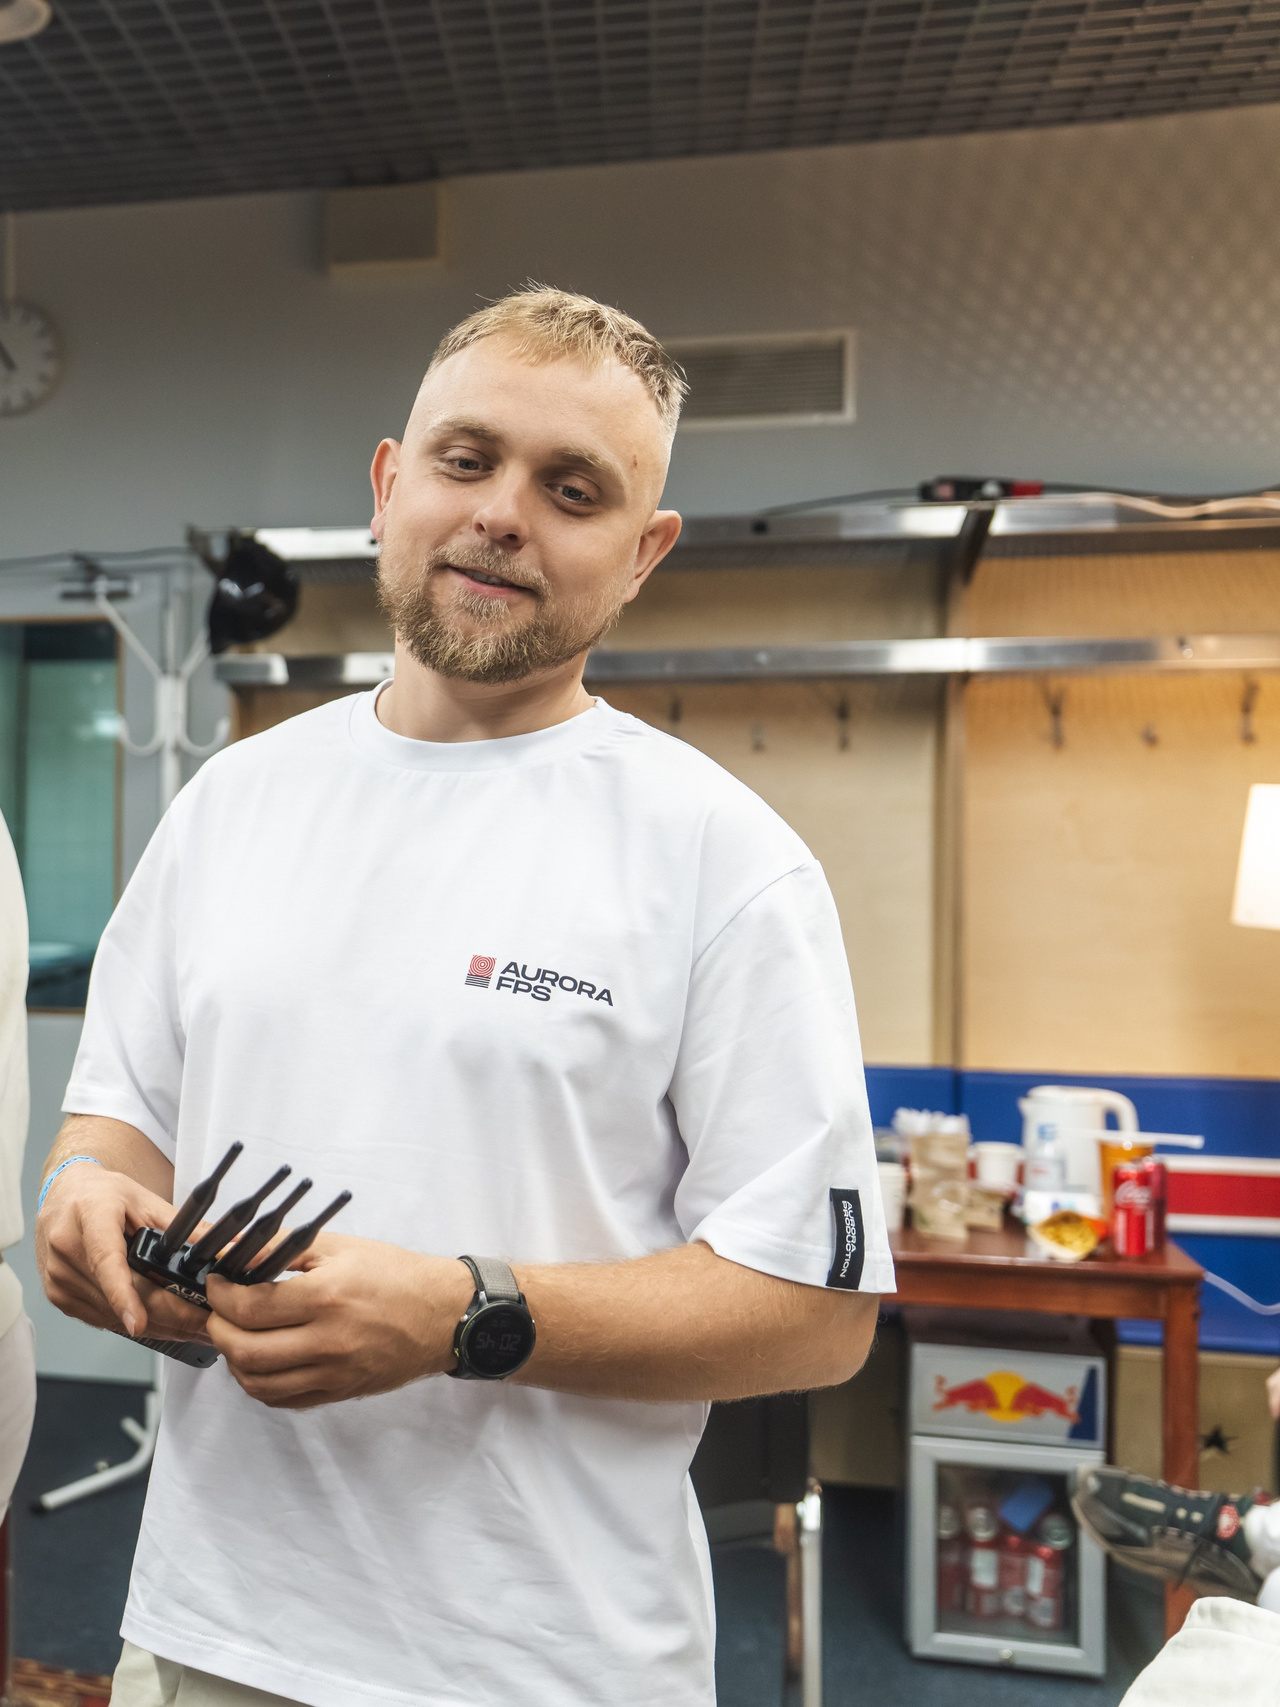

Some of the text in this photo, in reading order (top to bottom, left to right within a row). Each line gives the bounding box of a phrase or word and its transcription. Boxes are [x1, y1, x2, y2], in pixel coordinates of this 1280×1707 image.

[495, 975, 552, 1002] FPS
[500, 961, 614, 1007] AURORA
[839, 1200, 852, 1278] PRODUCTION
[846, 1200, 857, 1253] AURORA
[168, 1283, 208, 1303] AUR
